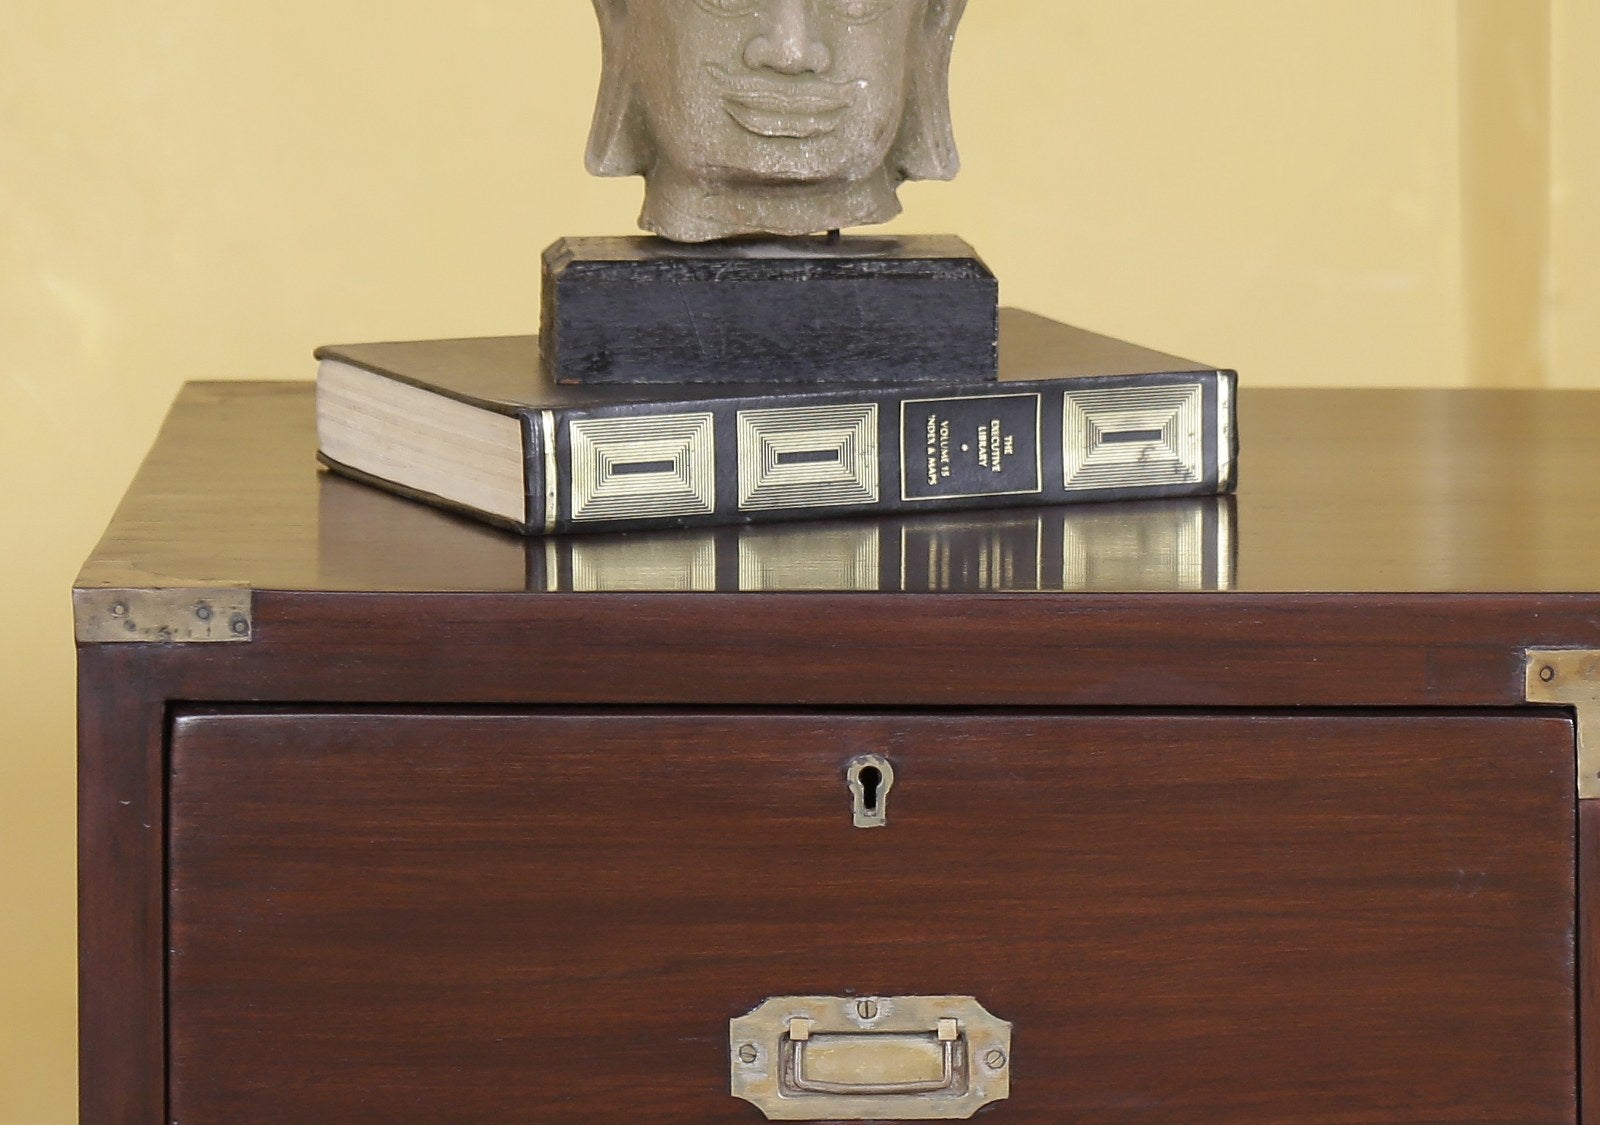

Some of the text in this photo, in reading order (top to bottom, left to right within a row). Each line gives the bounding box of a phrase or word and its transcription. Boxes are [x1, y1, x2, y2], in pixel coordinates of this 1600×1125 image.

[940, 421, 950, 463] VOLUME
[978, 426, 988, 467] LIBRARY
[991, 420, 1001, 472] EXECUTIVE
[1004, 435, 1013, 455] THE
[927, 457, 937, 485] MAPS
